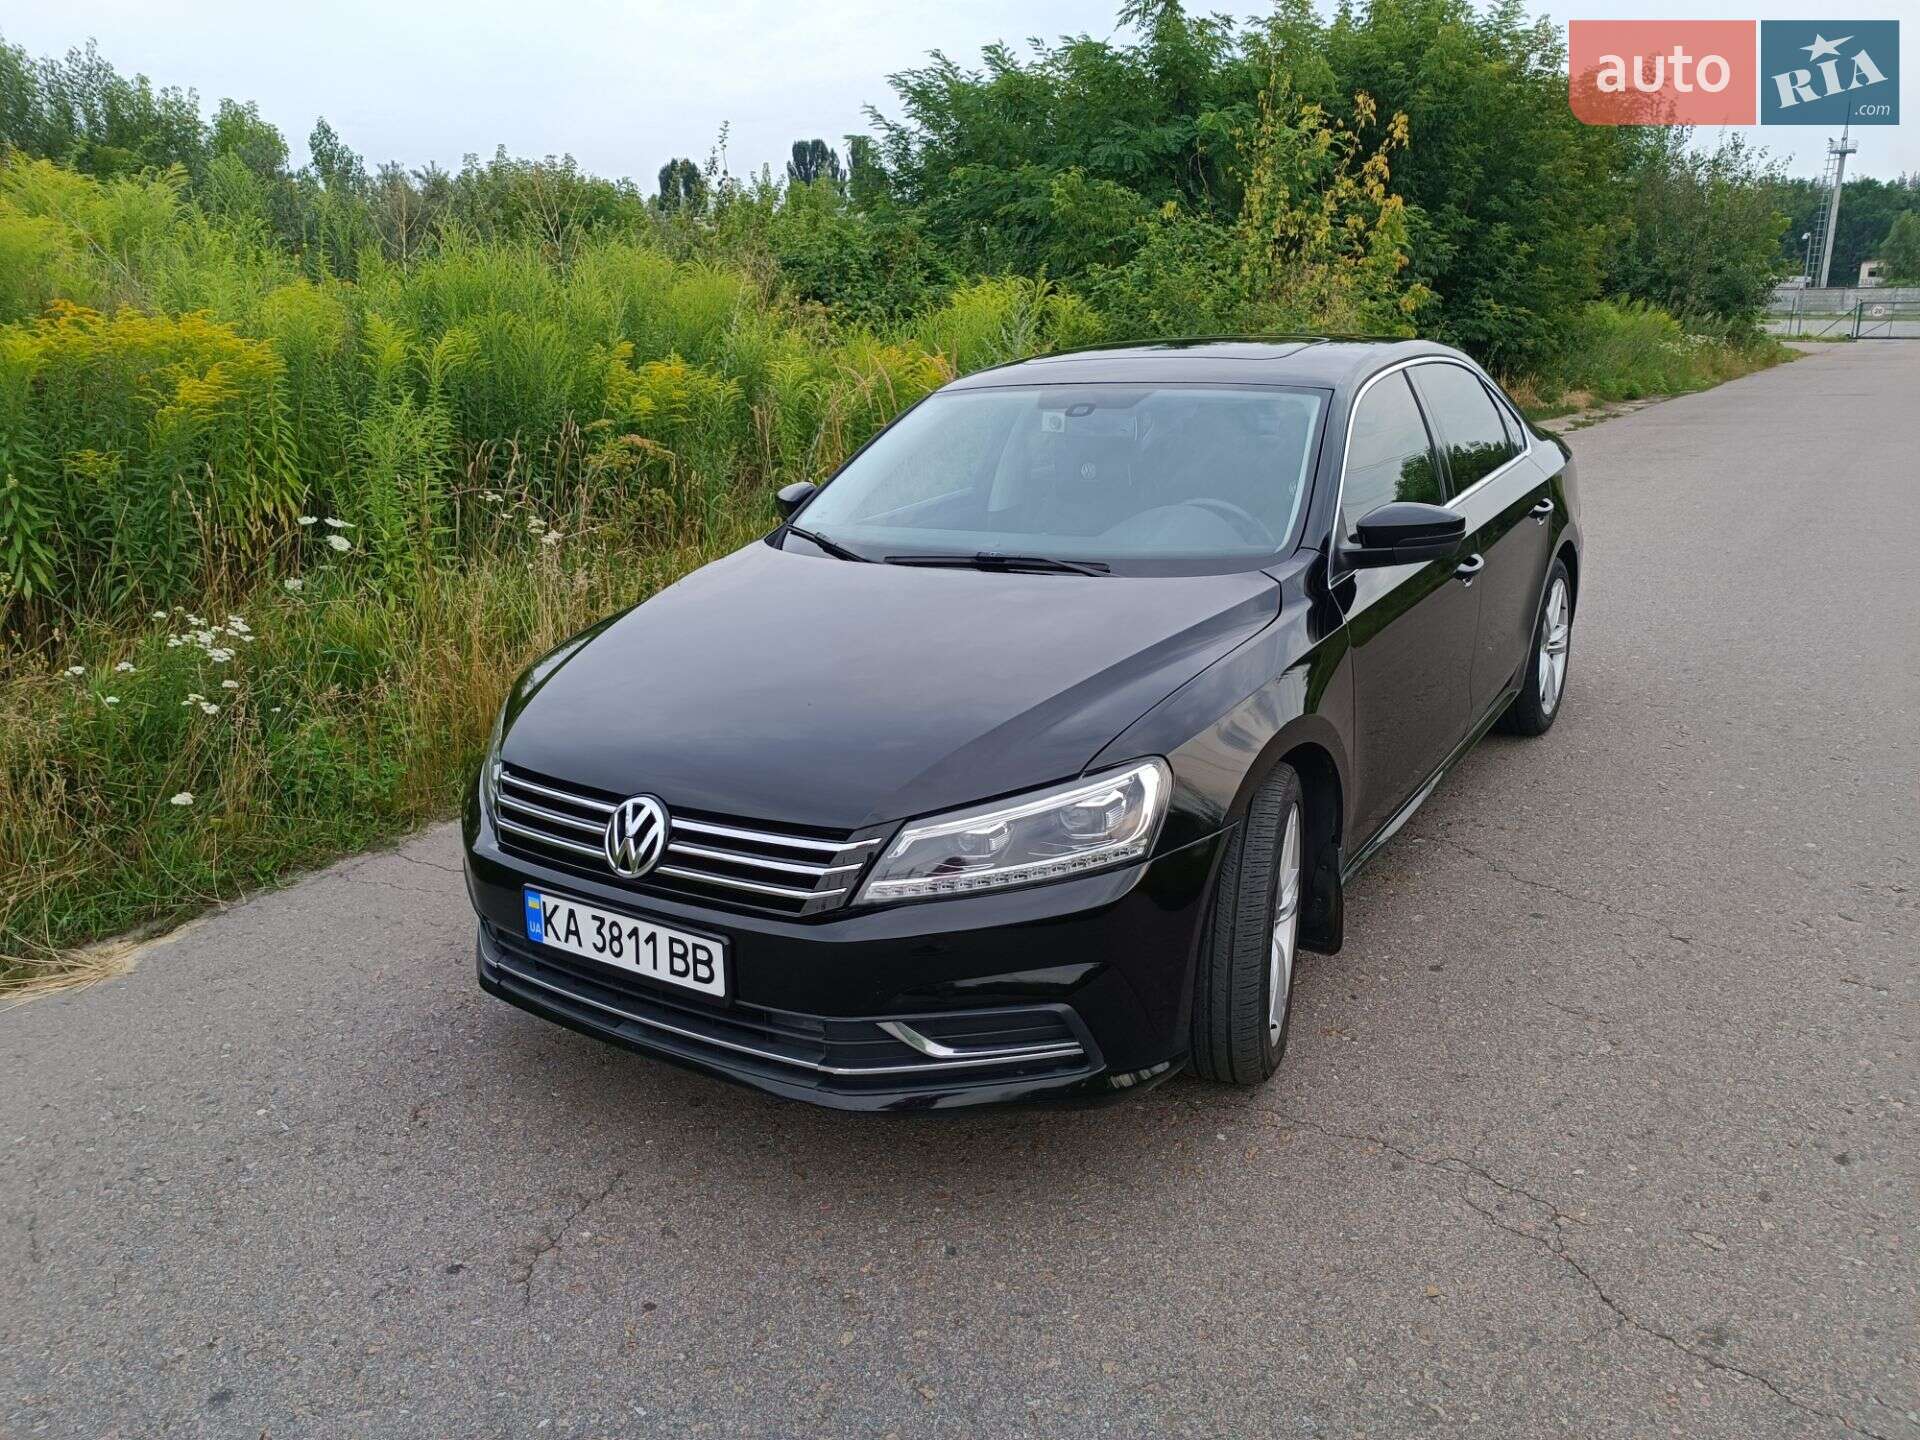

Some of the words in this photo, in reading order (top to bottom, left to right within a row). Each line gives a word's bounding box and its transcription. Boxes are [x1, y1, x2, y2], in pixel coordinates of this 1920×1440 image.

[530, 920, 541, 935] UA
[542, 901, 583, 948] KA
[591, 914, 658, 971] 3811
[668, 936, 715, 985] BB
